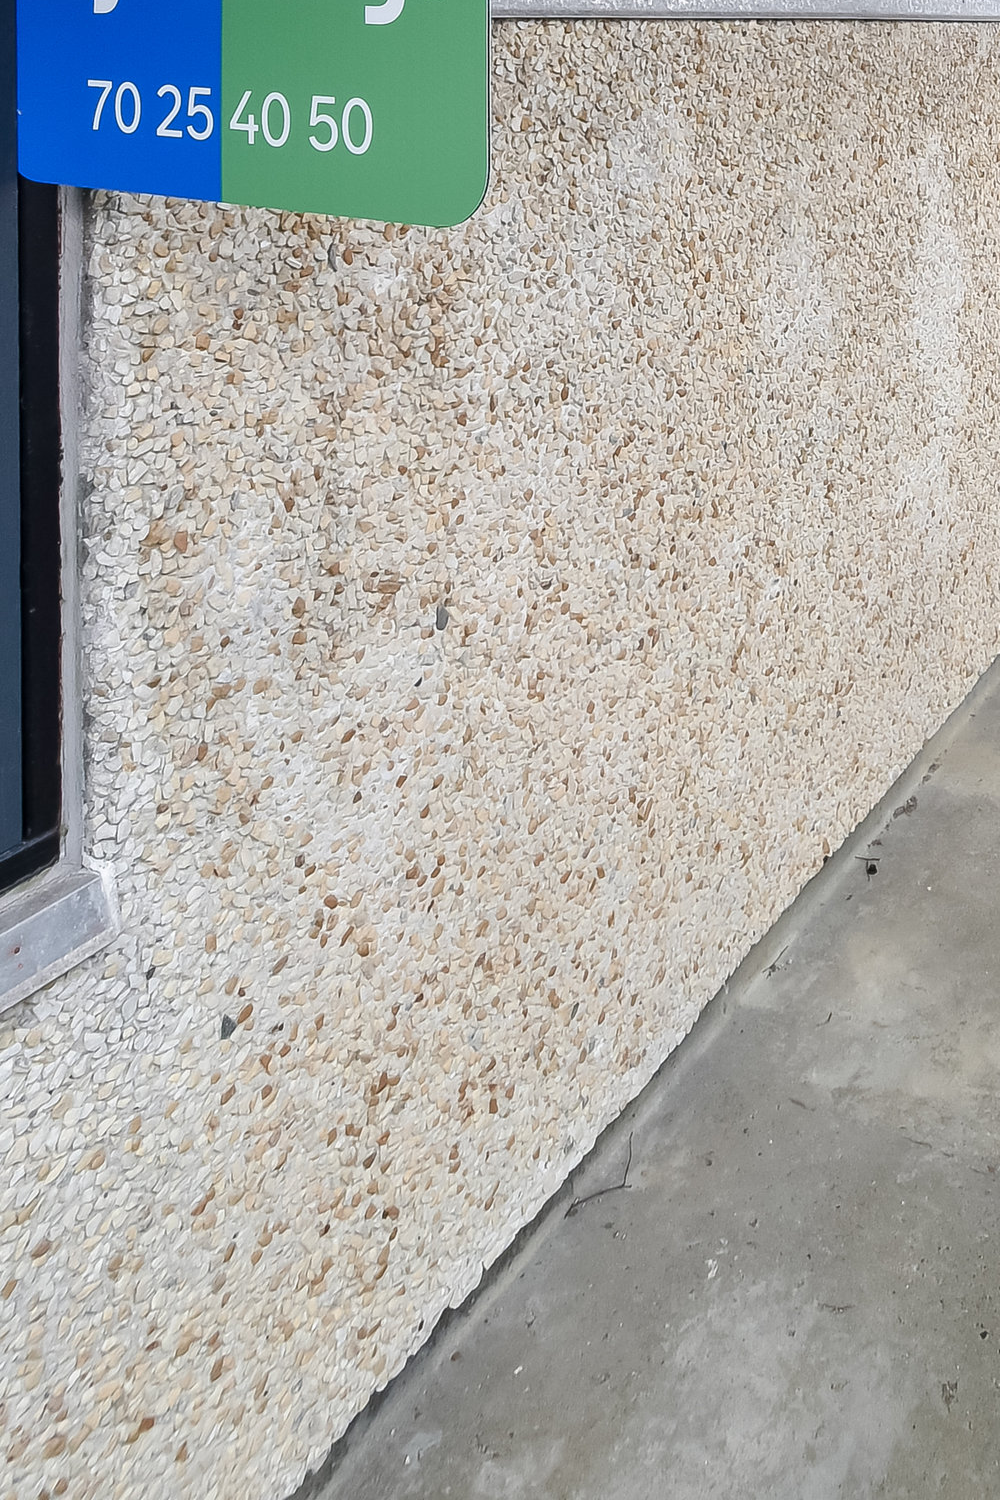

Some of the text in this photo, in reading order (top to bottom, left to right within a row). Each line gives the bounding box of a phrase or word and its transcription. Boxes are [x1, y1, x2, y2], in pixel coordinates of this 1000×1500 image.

[87, 79, 373, 155] 70 25 40 50
